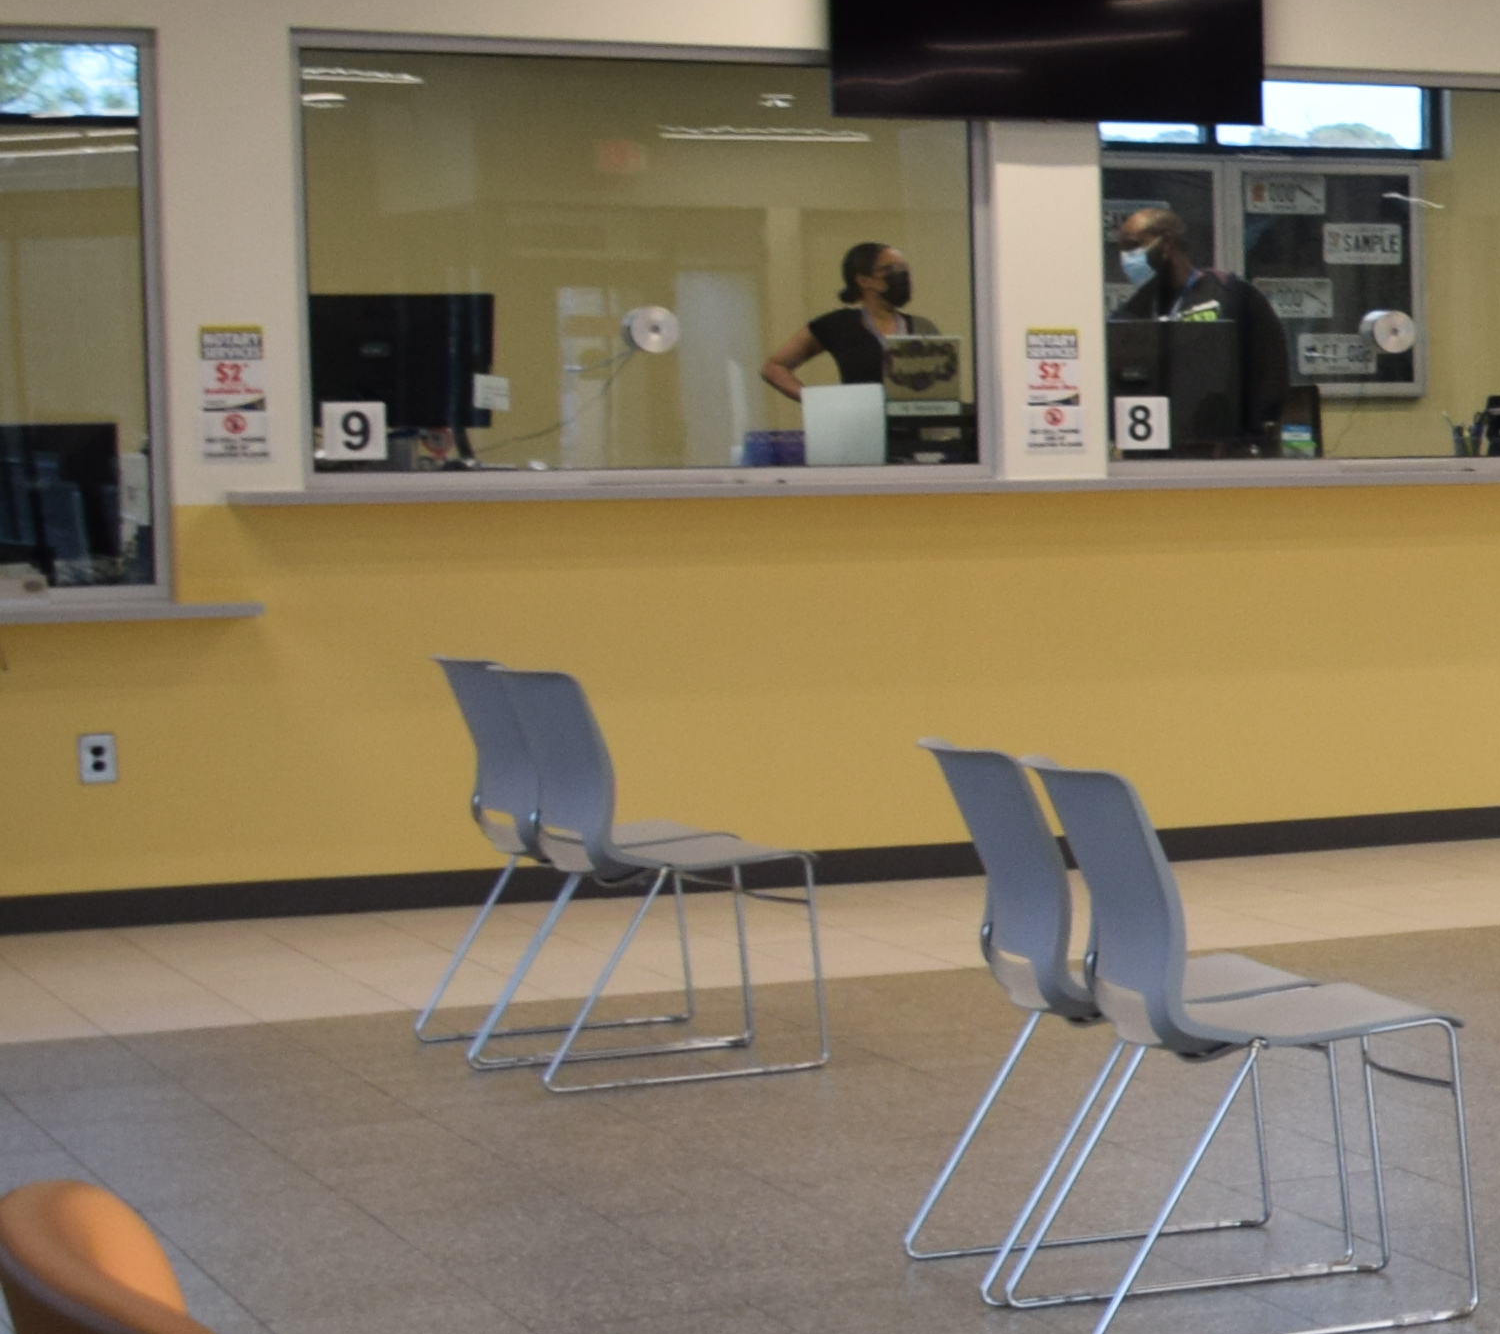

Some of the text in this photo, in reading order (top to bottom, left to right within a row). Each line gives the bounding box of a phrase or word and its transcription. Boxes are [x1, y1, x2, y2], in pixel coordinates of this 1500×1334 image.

[1343, 234, 1399, 253] SAMPLE
[341, 410, 371, 451] 9
[1129, 404, 1153, 442] 8
